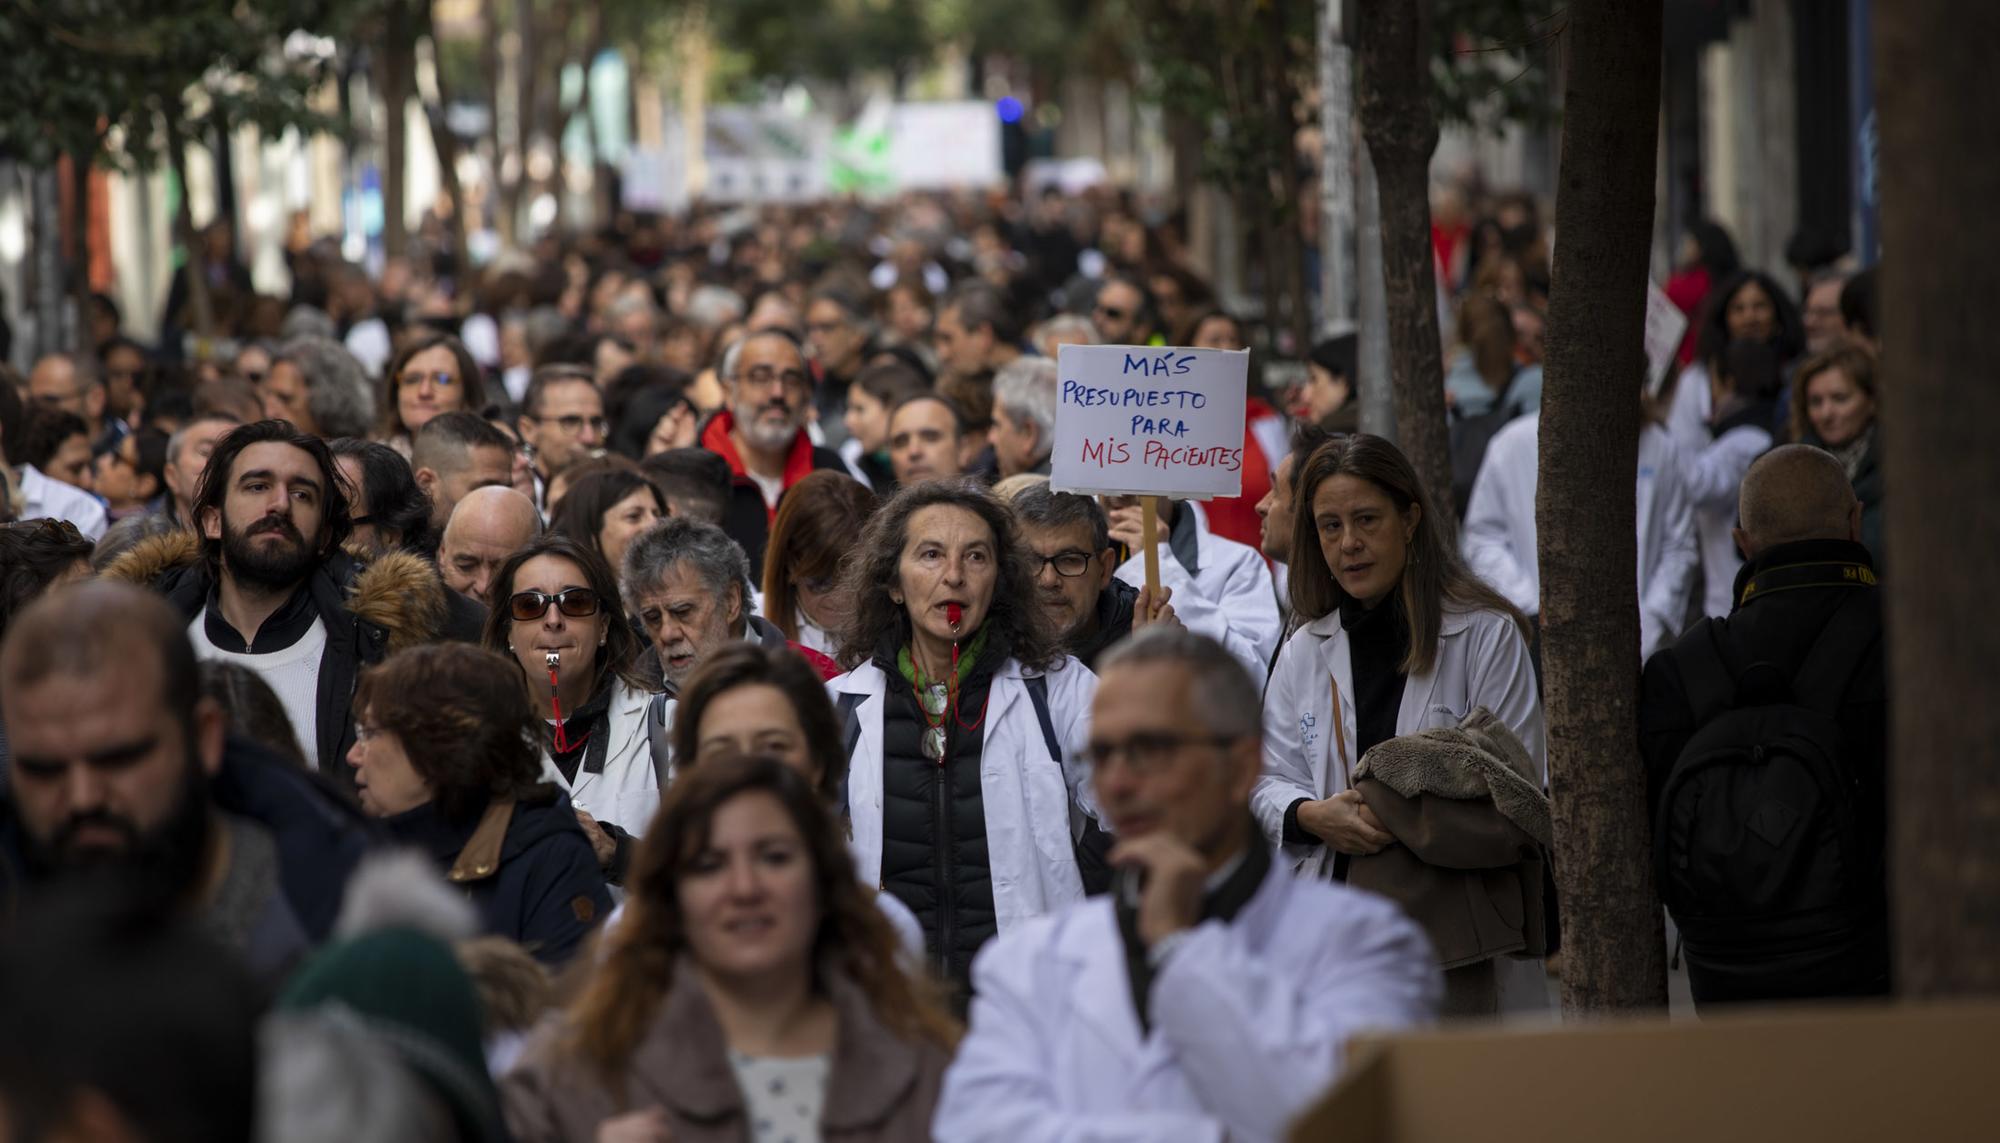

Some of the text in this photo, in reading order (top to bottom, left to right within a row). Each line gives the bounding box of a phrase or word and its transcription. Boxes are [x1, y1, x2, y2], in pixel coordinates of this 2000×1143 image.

[1123, 352, 1197, 377] MÁS
[1063, 380, 1207, 409] PRESUPUESTO
[1131, 415, 1190, 438] PARA
